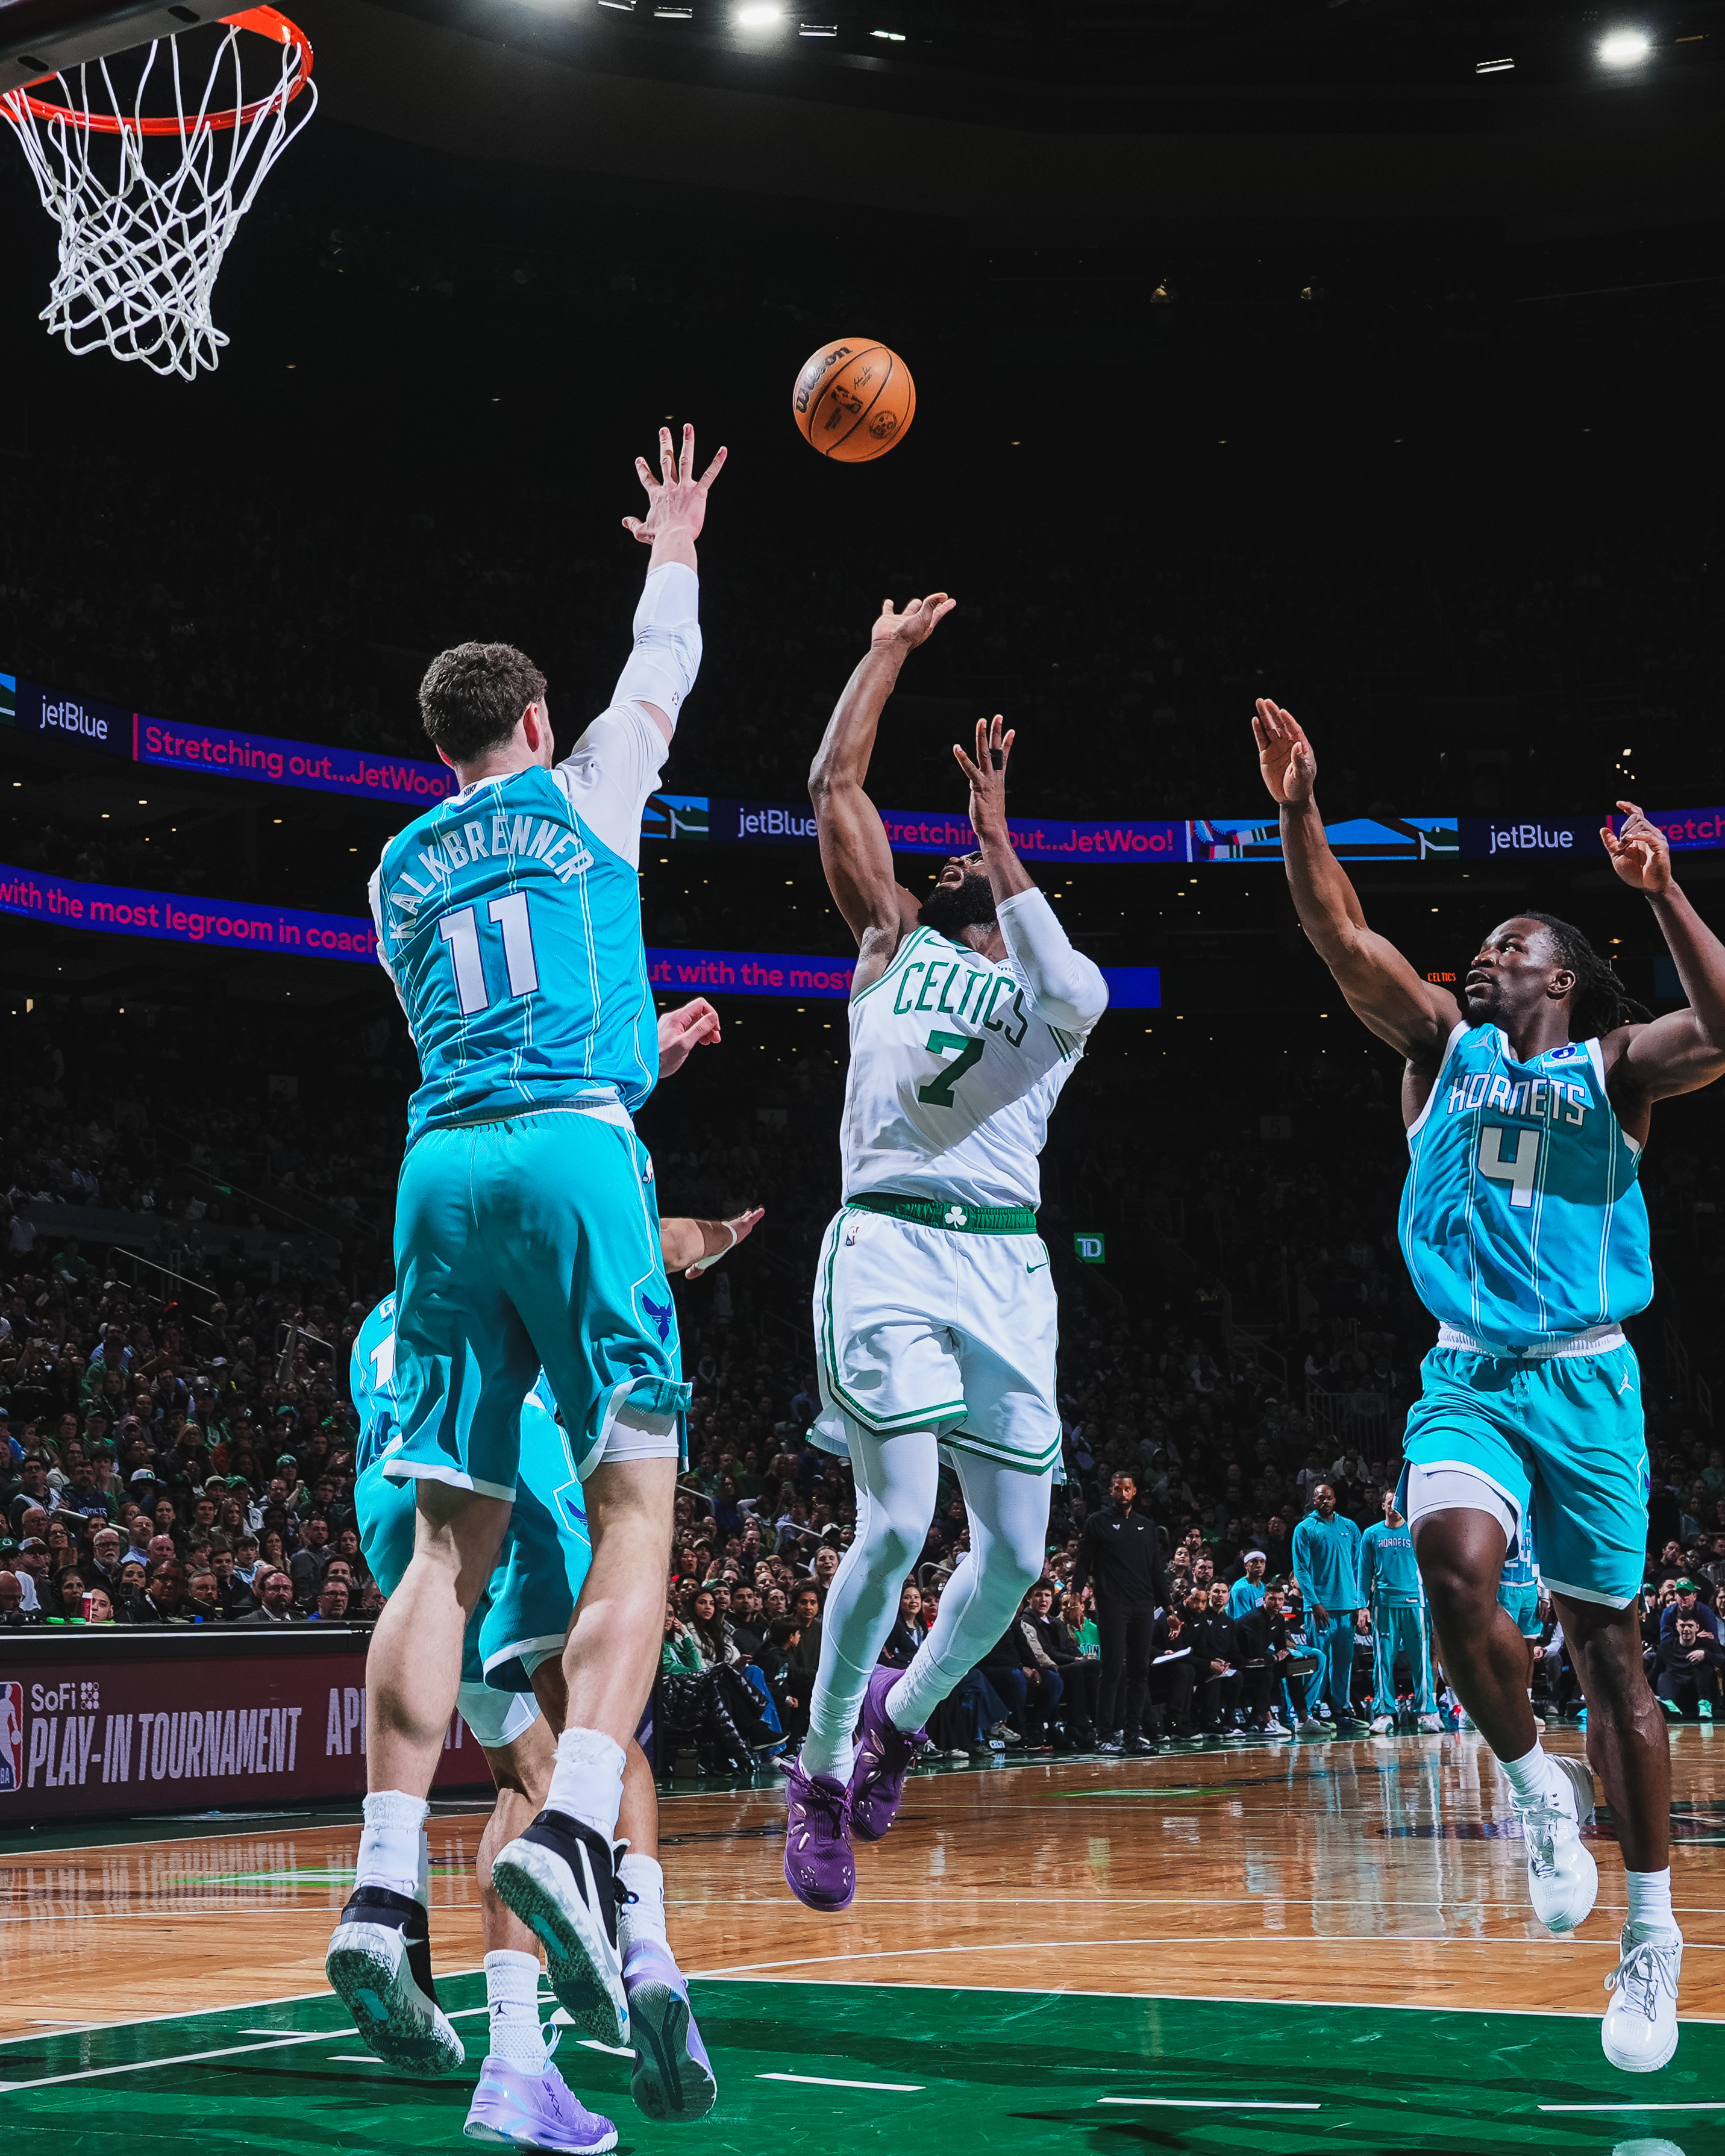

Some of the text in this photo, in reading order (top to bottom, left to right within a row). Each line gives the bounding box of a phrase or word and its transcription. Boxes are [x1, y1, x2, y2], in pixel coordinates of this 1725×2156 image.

[40, 695, 108, 740] jetBlue
[146, 727, 283, 778] Stretching
[737, 808, 818, 837] jetBlue
[1489, 825, 1574, 854] jetBlue
[390, 815, 595, 940] KALKBRENNER
[47, 888, 83, 918] the
[91, 902, 159, 928] most
[166, 904, 272, 940] legroom
[280, 917, 300, 945] in
[439, 890, 539, 1017] 11
[648, 960, 854, 989] ut with the most
[1427, 972, 1456, 982] CELTICS
[894, 961, 1028, 1048] CELTICS
[918, 1030, 986, 1108] 7
[1447, 1072, 1594, 1126] HORNETS
[1477, 1125, 1543, 1208] 4
[1077, 1238, 1102, 1257] TD
[1379, 1538, 1411, 1548] HORNETS
[31, 1683, 76, 1712] SoFi
[28, 1707, 302, 1788] PLAY-IN TOURNAMENT
